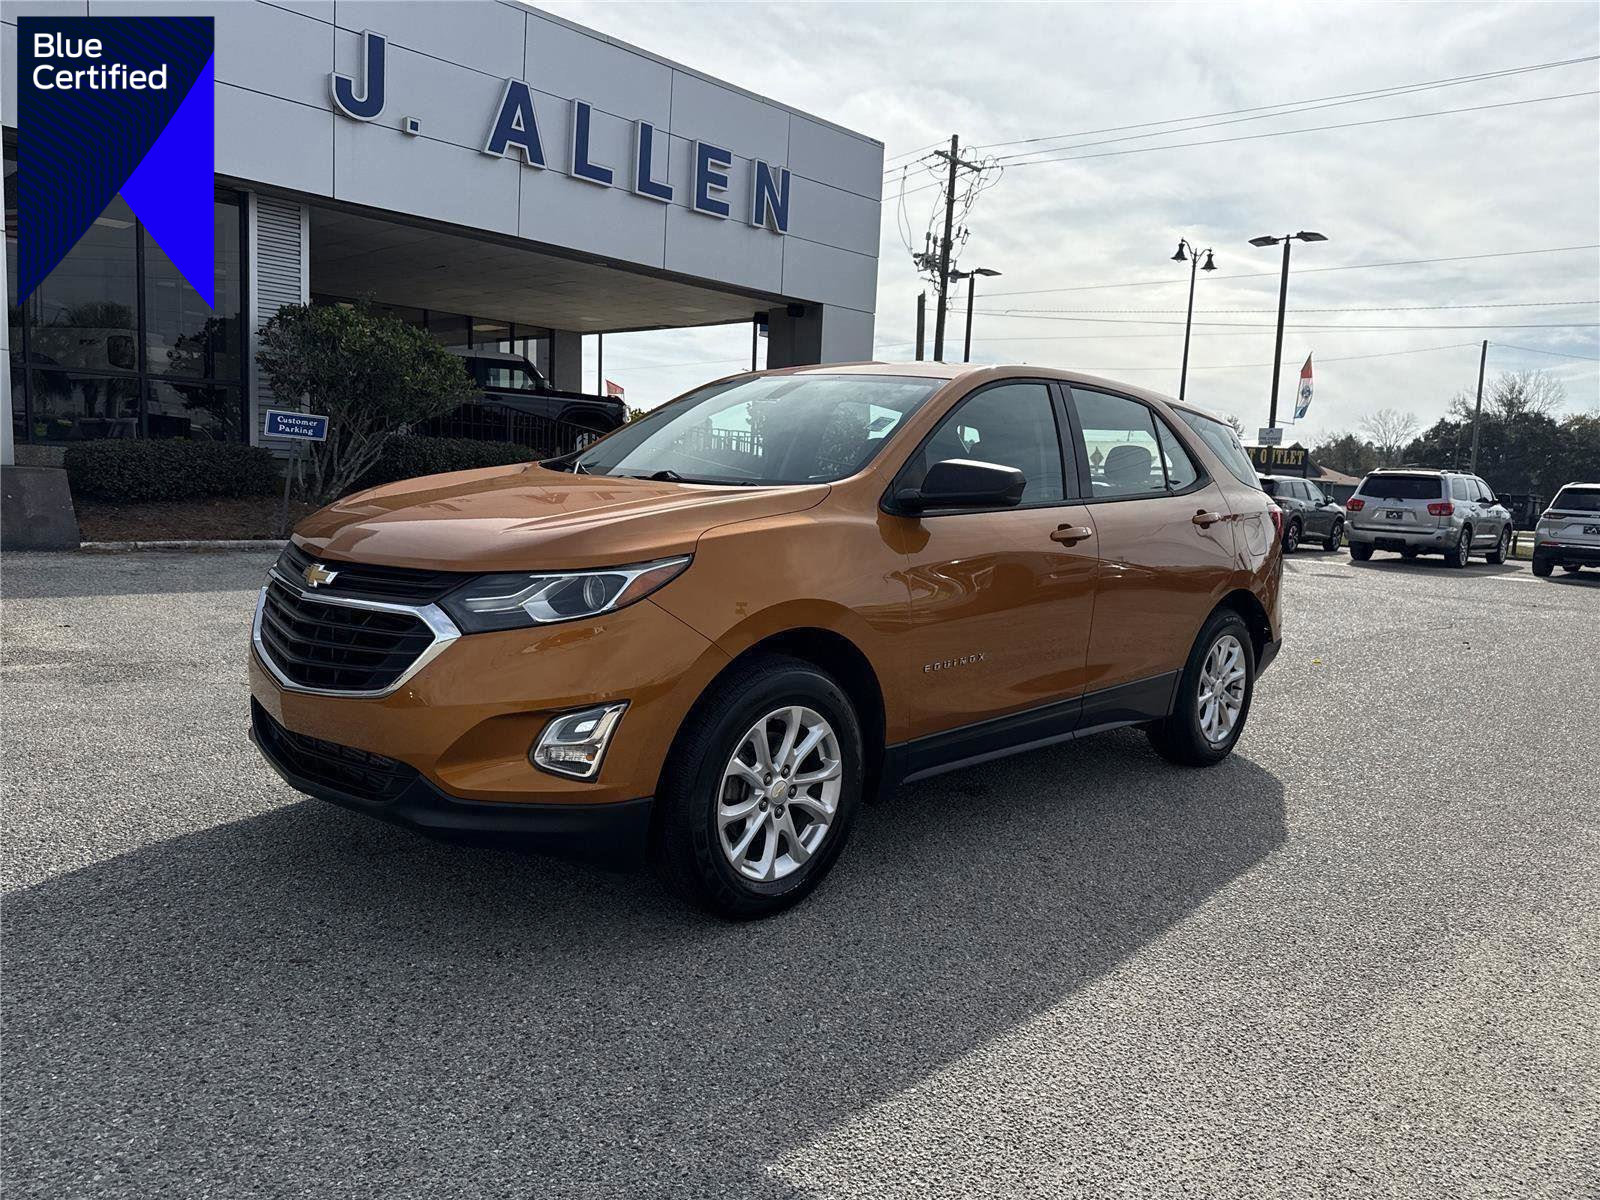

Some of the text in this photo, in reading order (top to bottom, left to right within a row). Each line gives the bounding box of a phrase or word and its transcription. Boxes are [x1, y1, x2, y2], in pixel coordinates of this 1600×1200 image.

[328, 29, 792, 235] J. ALLEN
[277, 415, 318, 427] Customer
[278, 424, 314, 436] Parking
[923, 652, 985, 673] EQUINOX
